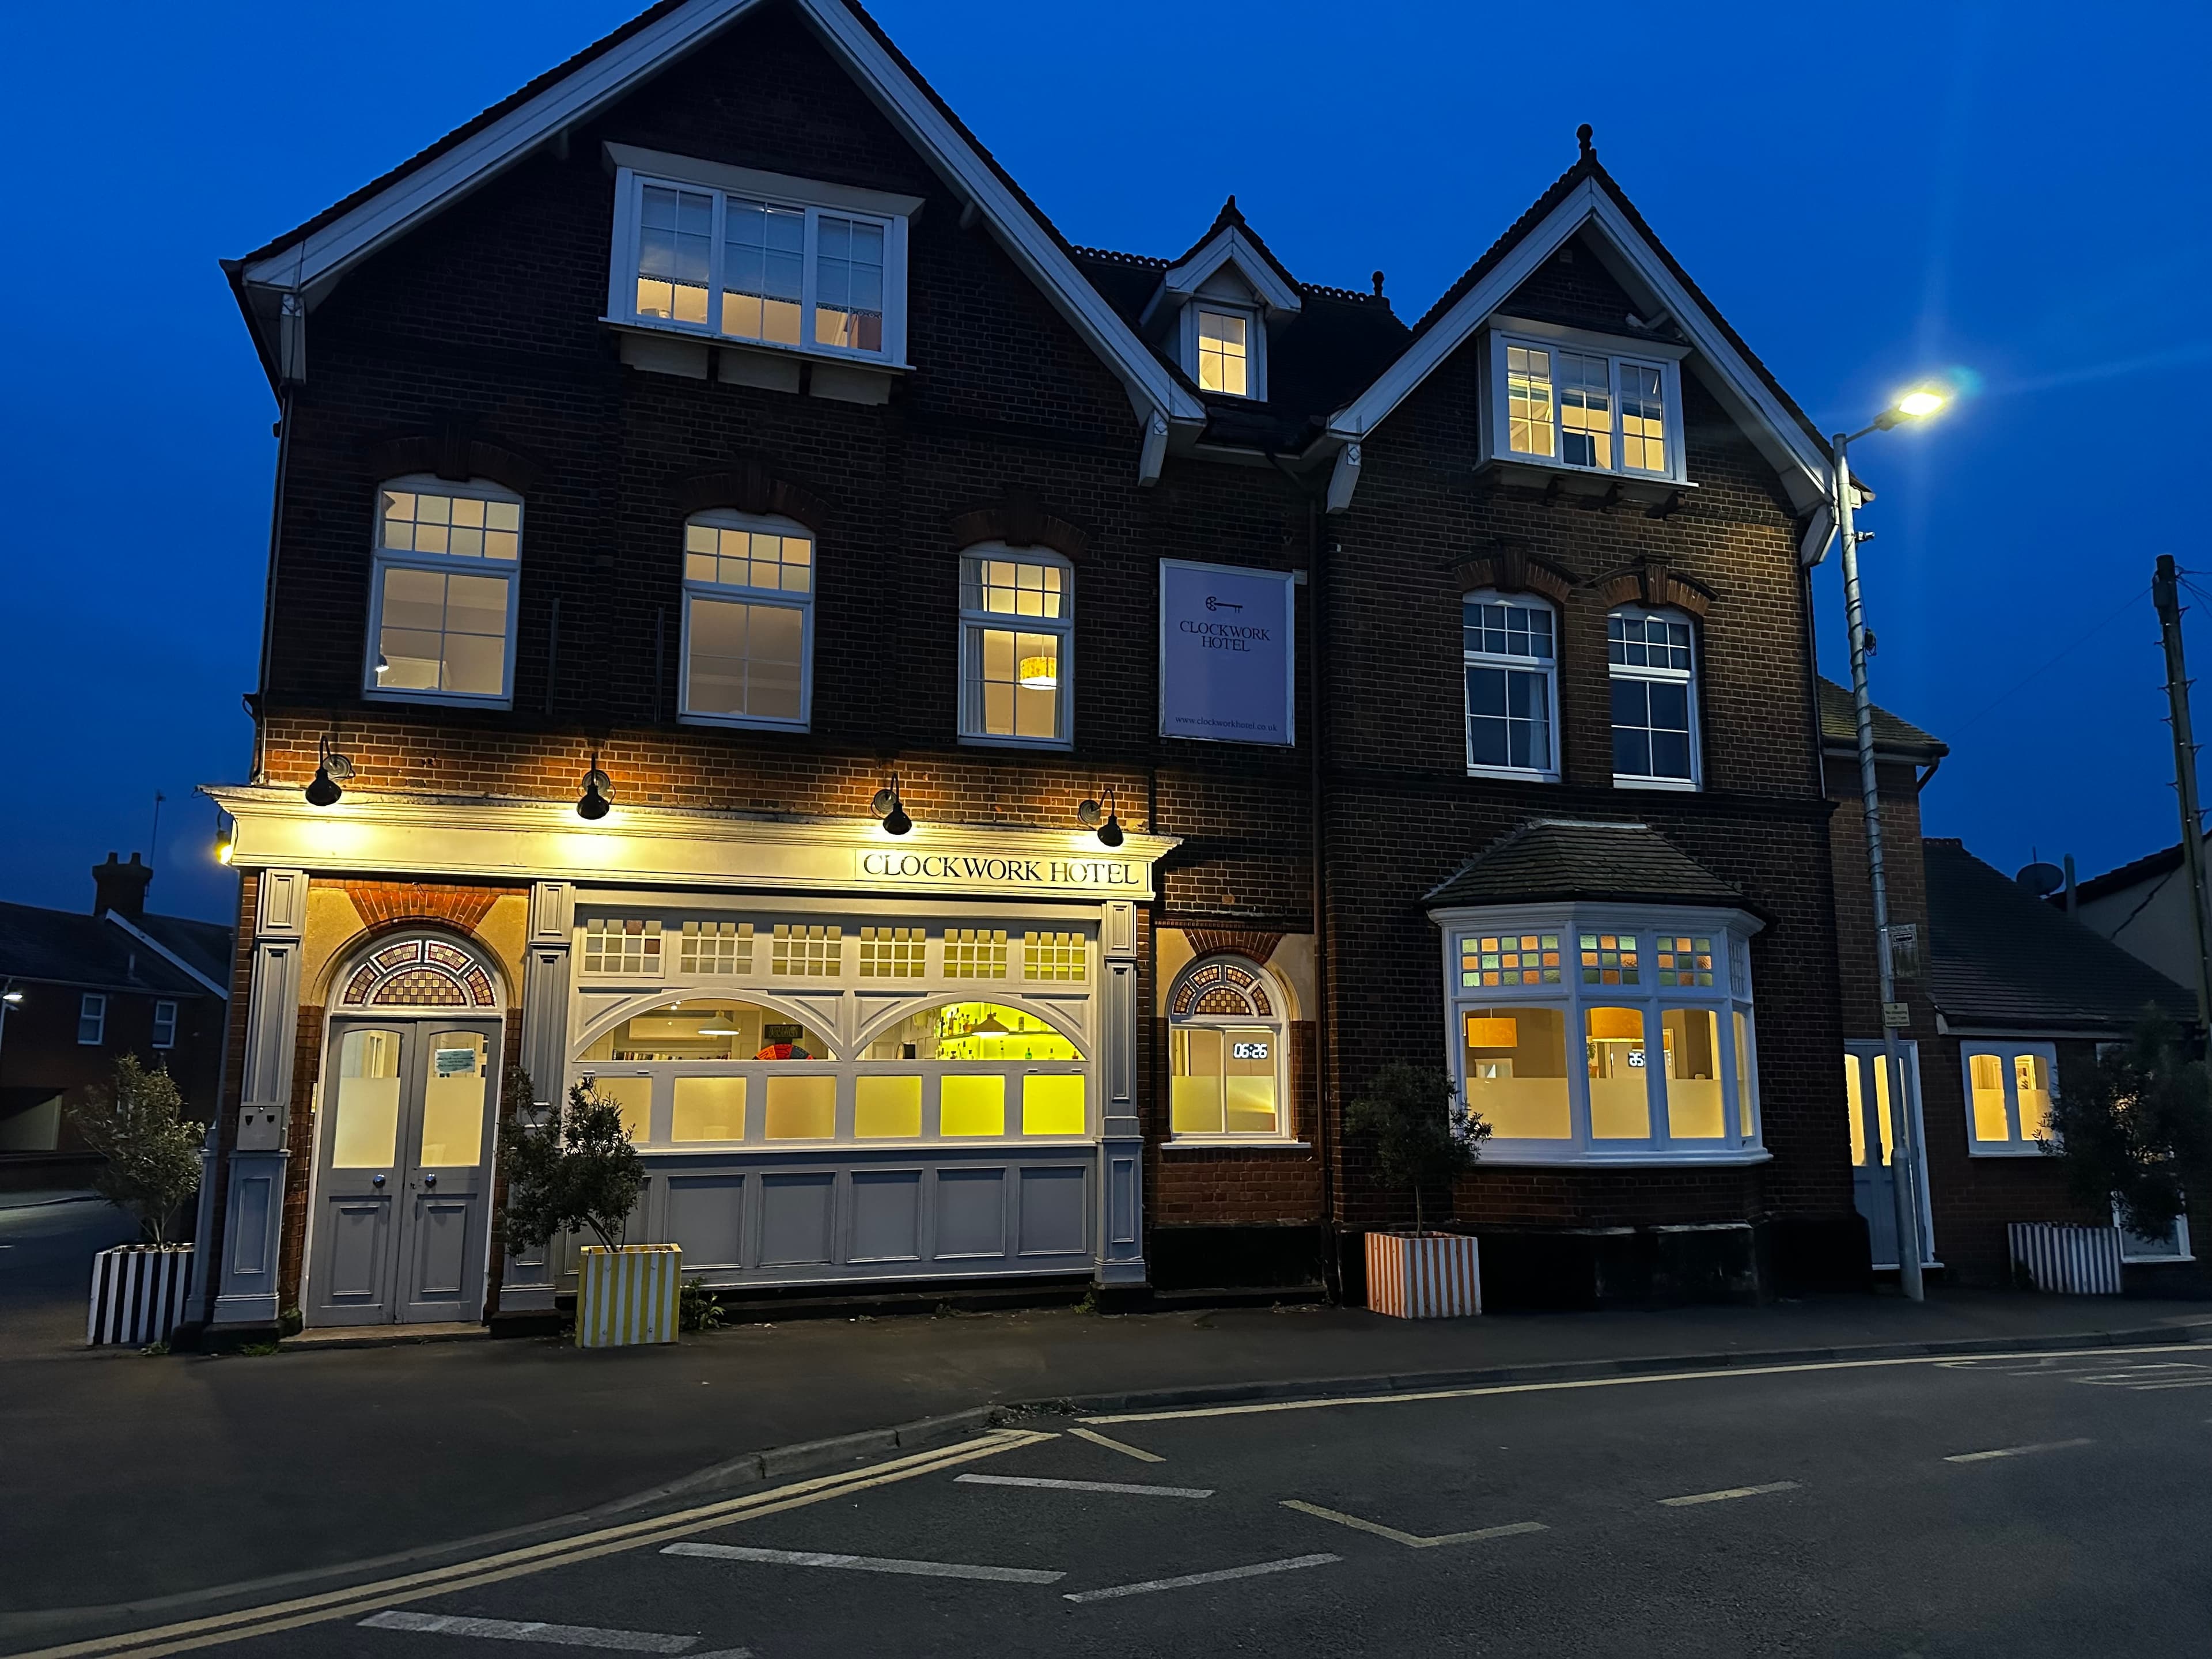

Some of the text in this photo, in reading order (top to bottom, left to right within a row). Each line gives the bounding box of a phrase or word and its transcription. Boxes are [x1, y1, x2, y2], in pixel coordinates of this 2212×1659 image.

[1180, 620, 1271, 641] CLOCKWORK
[1202, 636, 1251, 652] HOTEL
[1175, 717, 1277, 732] www.clockworkhotel.co.uk
[863, 853, 1139, 884] CLOCKWORK HOTEL
[1233, 1043, 1267, 1058] 06:26
